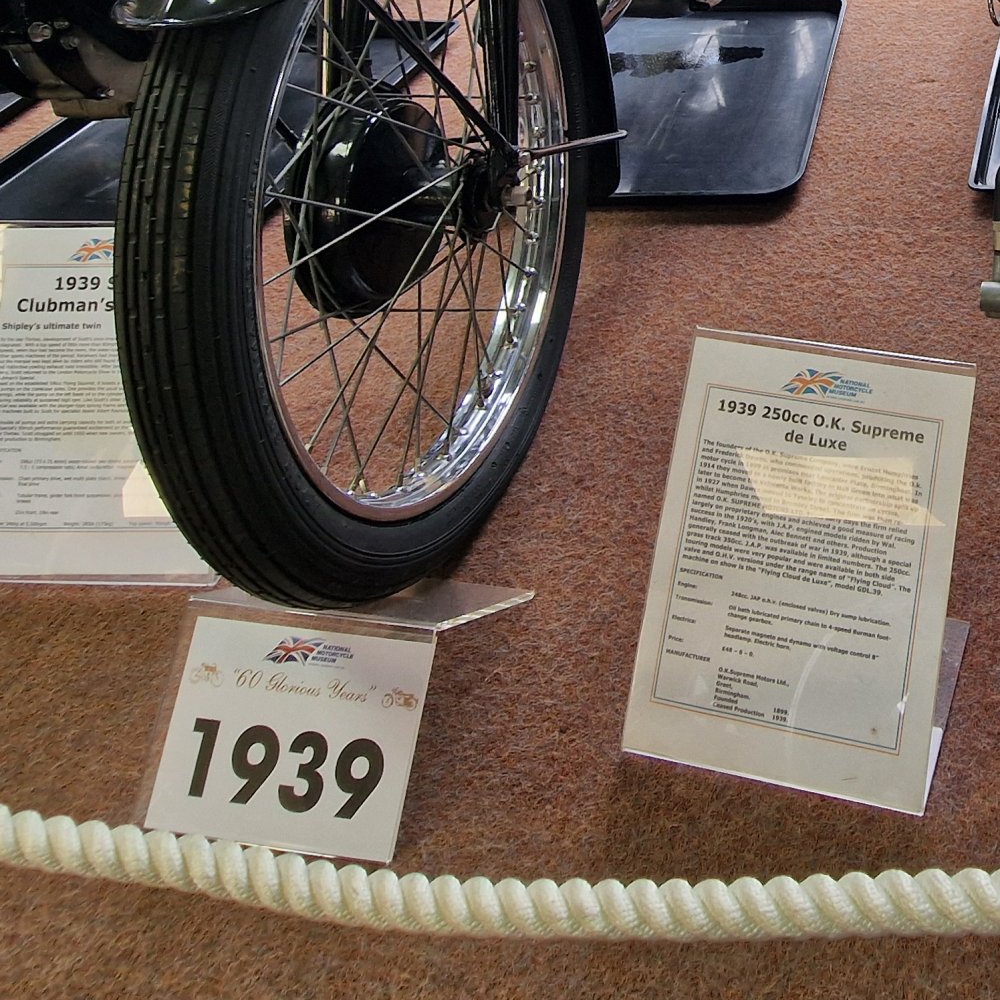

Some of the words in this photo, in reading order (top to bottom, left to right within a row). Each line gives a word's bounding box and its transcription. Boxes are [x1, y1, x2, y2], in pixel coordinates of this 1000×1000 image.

[55, 276, 101, 290] 1939
[17, 298, 115, 312] Clubman's
[2, 322, 40, 331] Shipley's
[43, 322, 80, 330] ultimate
[82, 322, 102, 330] twin
[833, 384, 873, 394] MOTORCYCLE
[840, 379, 871, 388] NATIONAL
[828, 389, 857, 397] MUSEUM
[717, 397, 757, 417] 1939
[761, 404, 809, 425] 250cc
[812, 413, 846, 431] O.K.
[850, 419, 925, 447] Supreme
[783, 427, 805, 444] de
[808, 432, 848, 452] Luxe
[316, 650, 354, 659] MOTORCYCLE
[265, 672, 321, 697] Glorious
[188, 717, 384, 820] 1939
